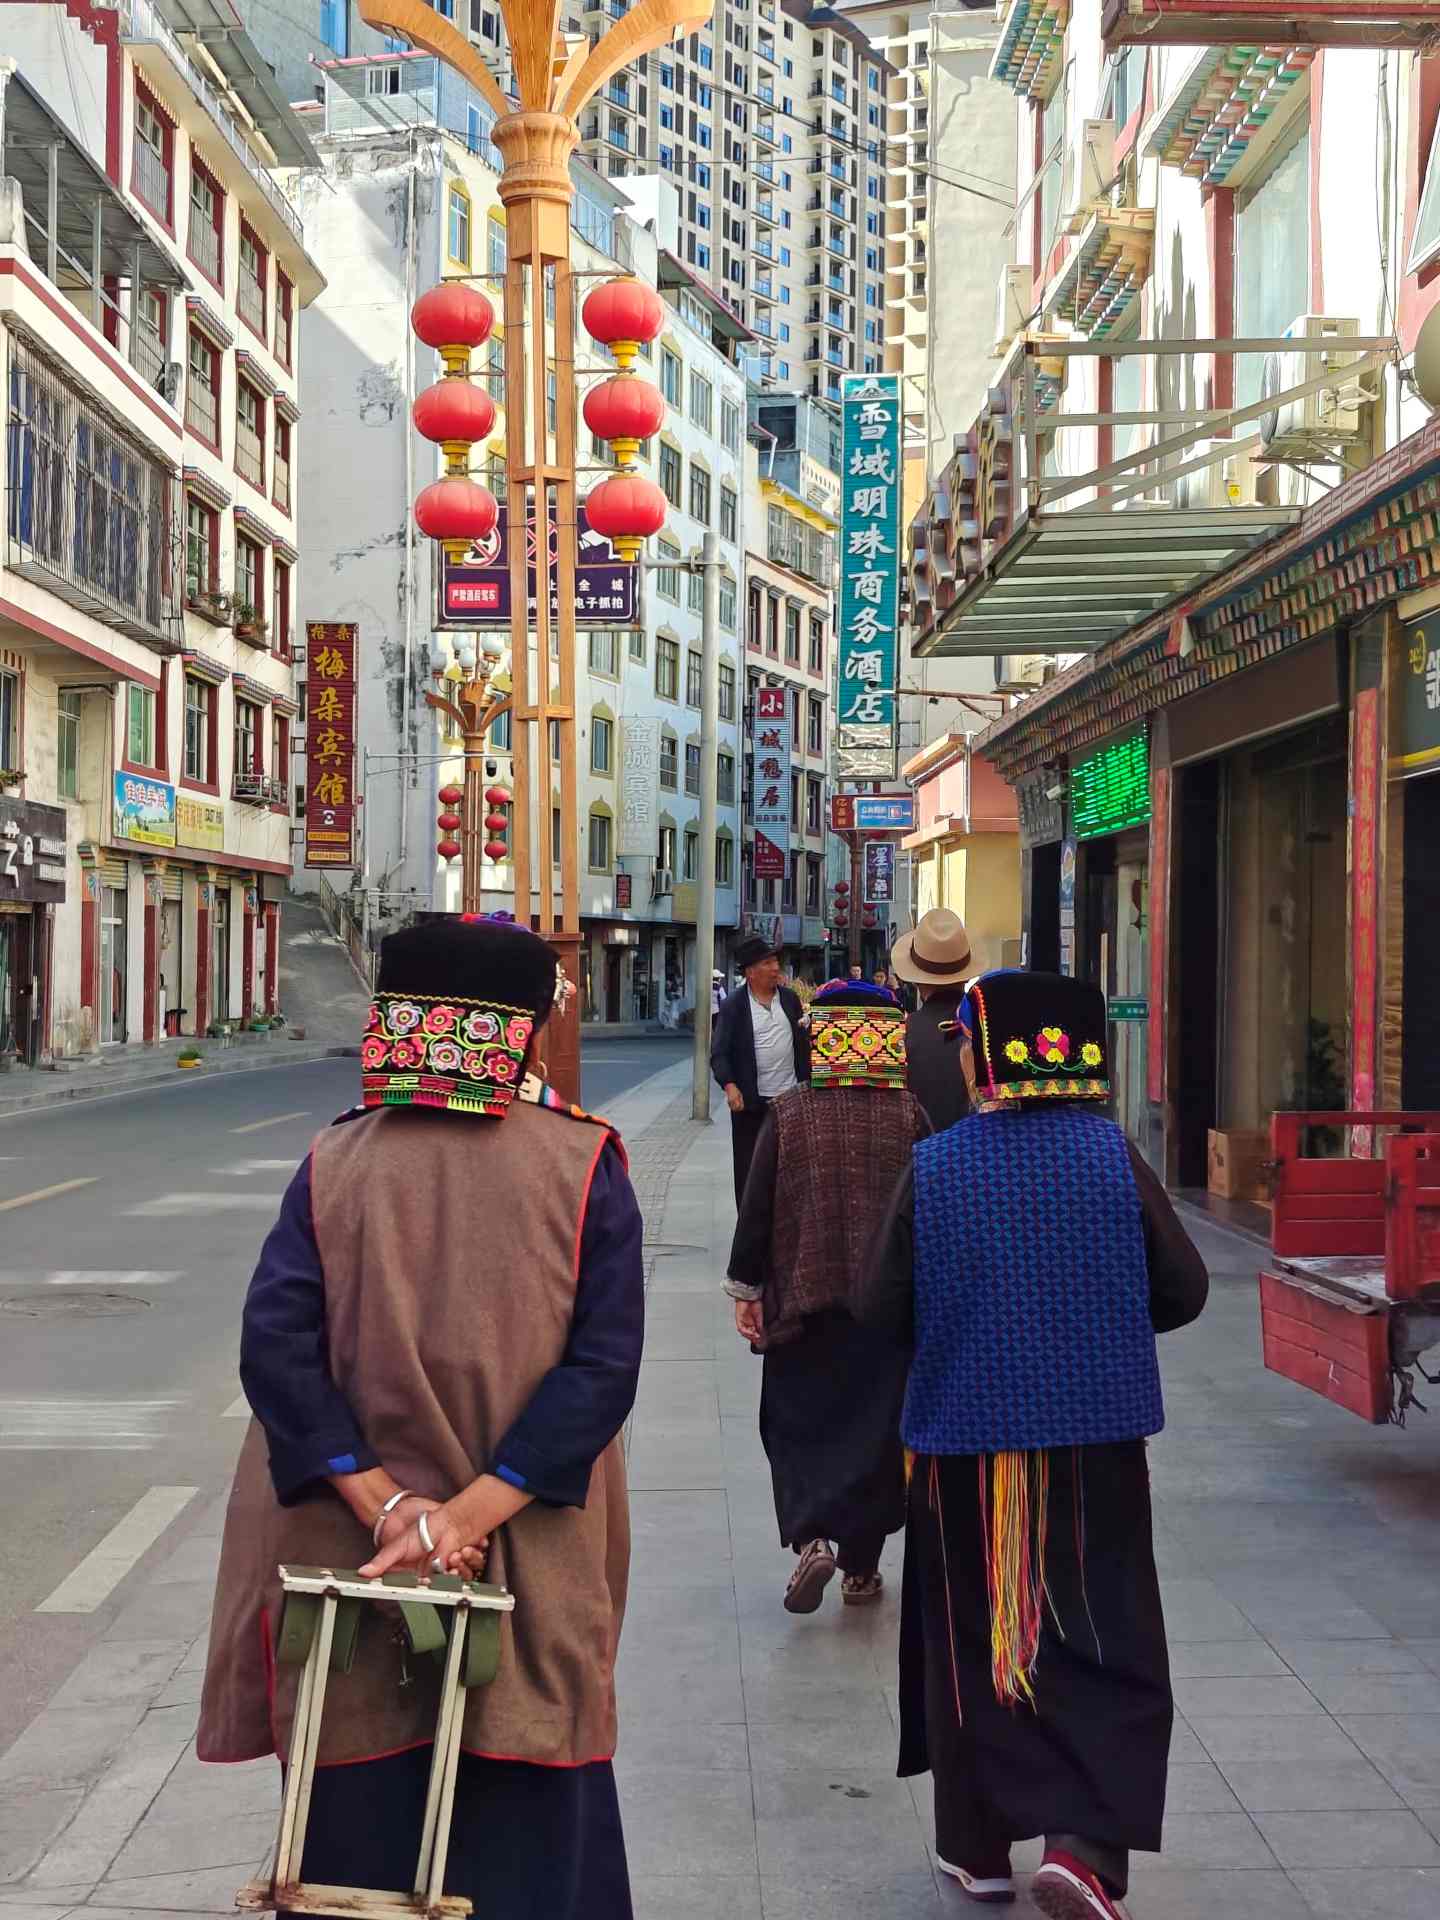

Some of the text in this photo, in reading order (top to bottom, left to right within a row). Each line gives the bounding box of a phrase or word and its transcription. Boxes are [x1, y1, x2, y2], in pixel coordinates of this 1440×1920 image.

[574, 597, 624, 609] 电子抓拍
[311, 645, 349, 806] 梅朵宾馆
[623, 718, 651, 825] 金城宾馆
